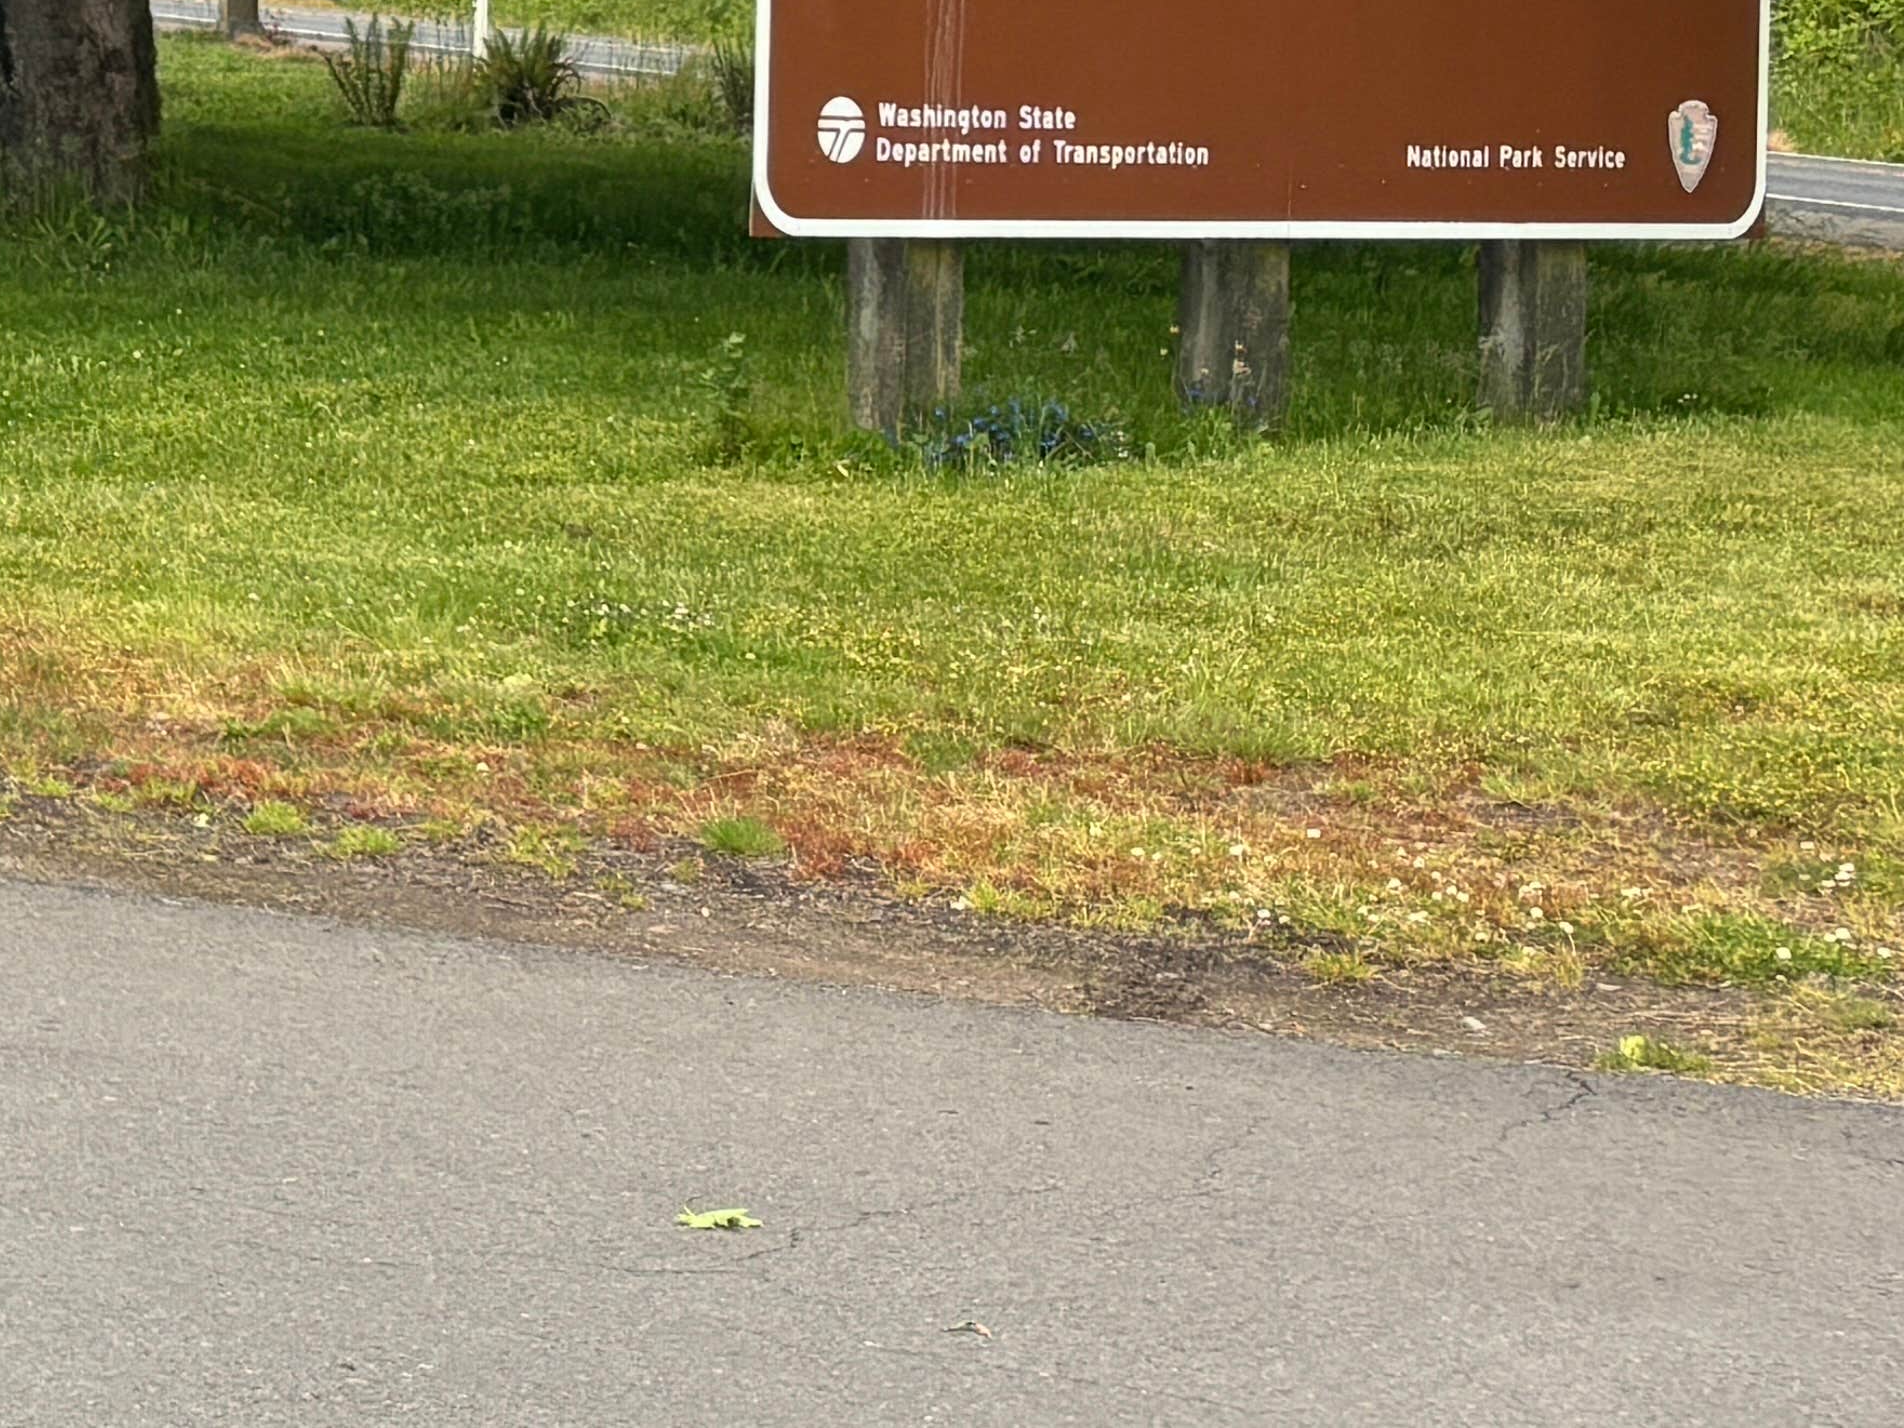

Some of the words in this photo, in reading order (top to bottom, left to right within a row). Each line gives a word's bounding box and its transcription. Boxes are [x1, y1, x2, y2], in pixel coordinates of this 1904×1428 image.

[878, 102, 1007, 136] Washington
[1018, 105, 1076, 129] State
[876, 136, 1007, 168] Department
[1019, 139, 1041, 164] of
[1053, 139, 1209, 170] Transportation
[1406, 144, 1489, 168] National
[1499, 144, 1543, 170] Park
[1554, 145, 1626, 169] Service
